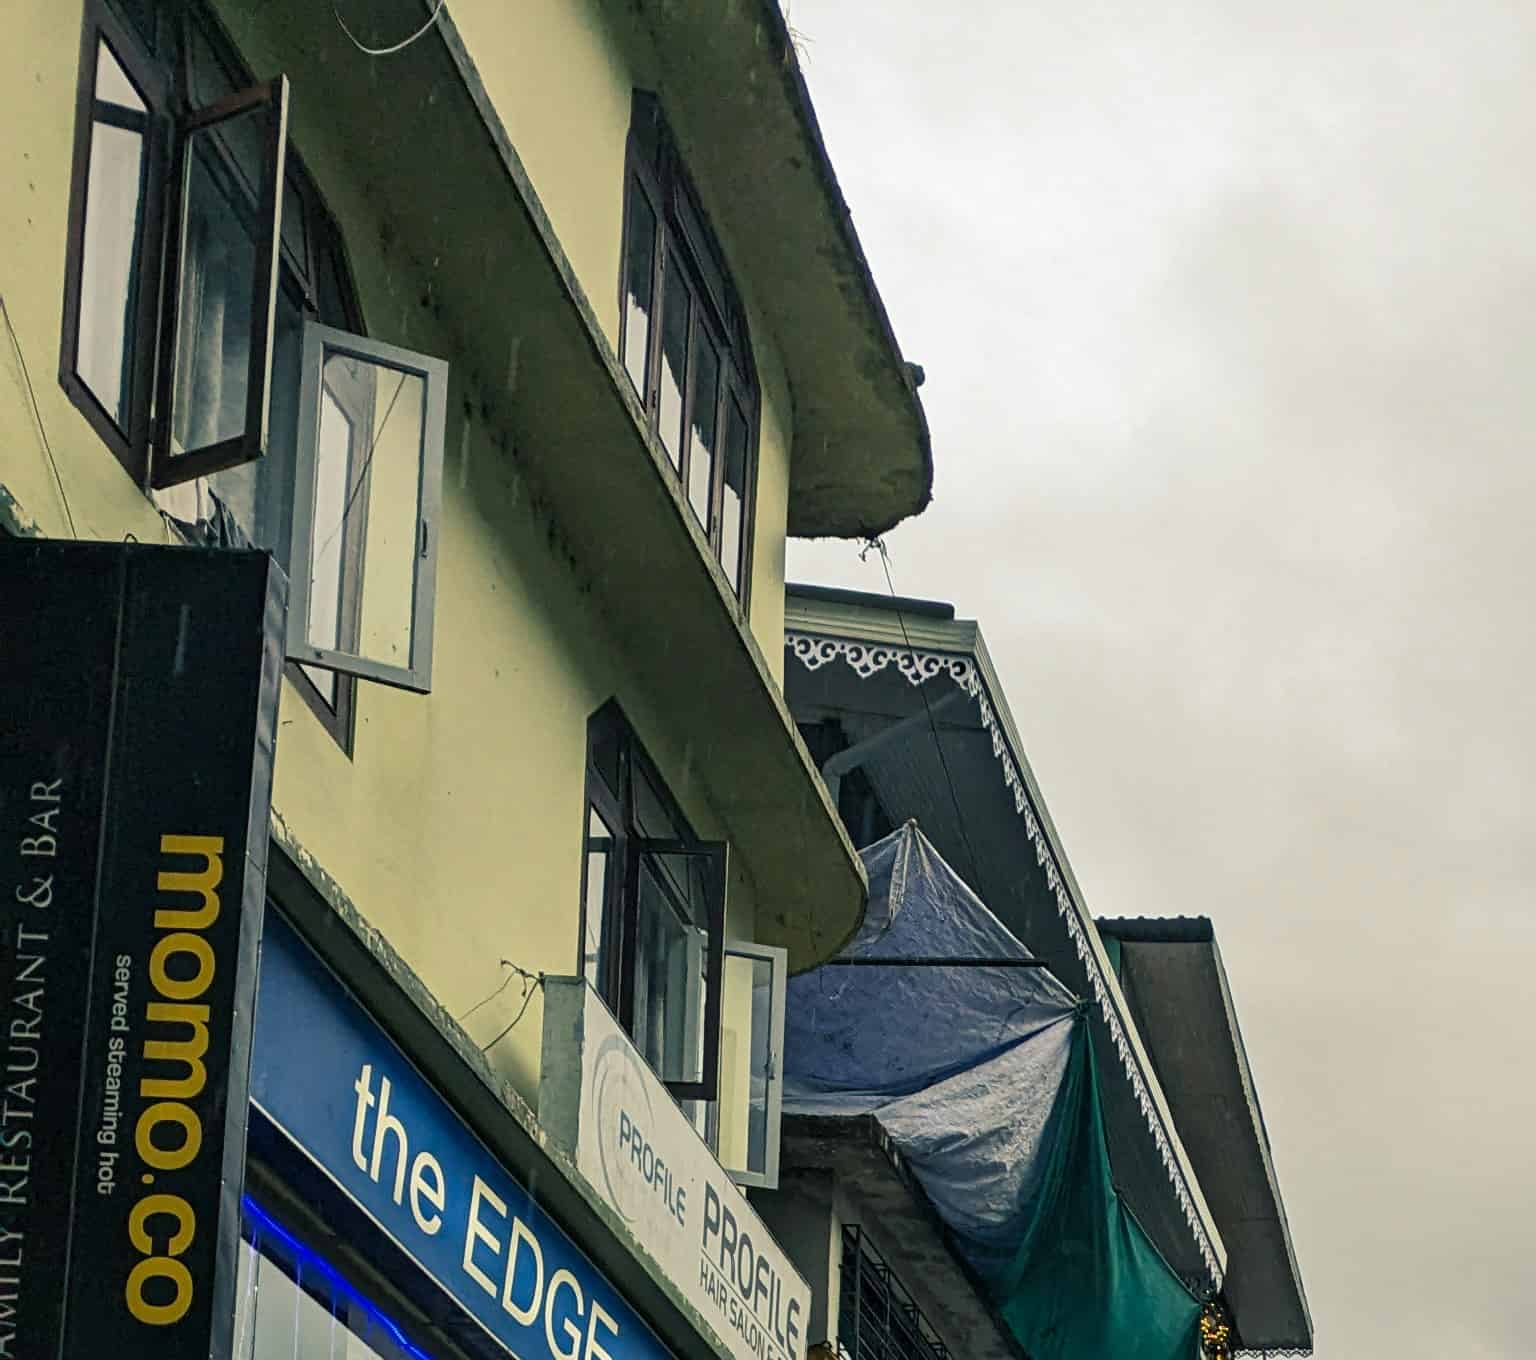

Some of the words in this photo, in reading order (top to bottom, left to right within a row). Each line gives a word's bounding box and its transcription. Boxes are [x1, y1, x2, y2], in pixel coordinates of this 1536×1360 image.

[20, 778, 63, 857] BAR
[15, 875, 54, 909] &
[110, 954, 132, 1031] served
[0, 923, 49, 1204] RESTAURANT
[97, 1036, 124, 1145] steaming
[125, 833, 225, 1326] momo.co
[352, 1062, 446, 1236] the
[619, 1108, 687, 1228] PROFILE
[700, 1258, 728, 1318] HAIR
